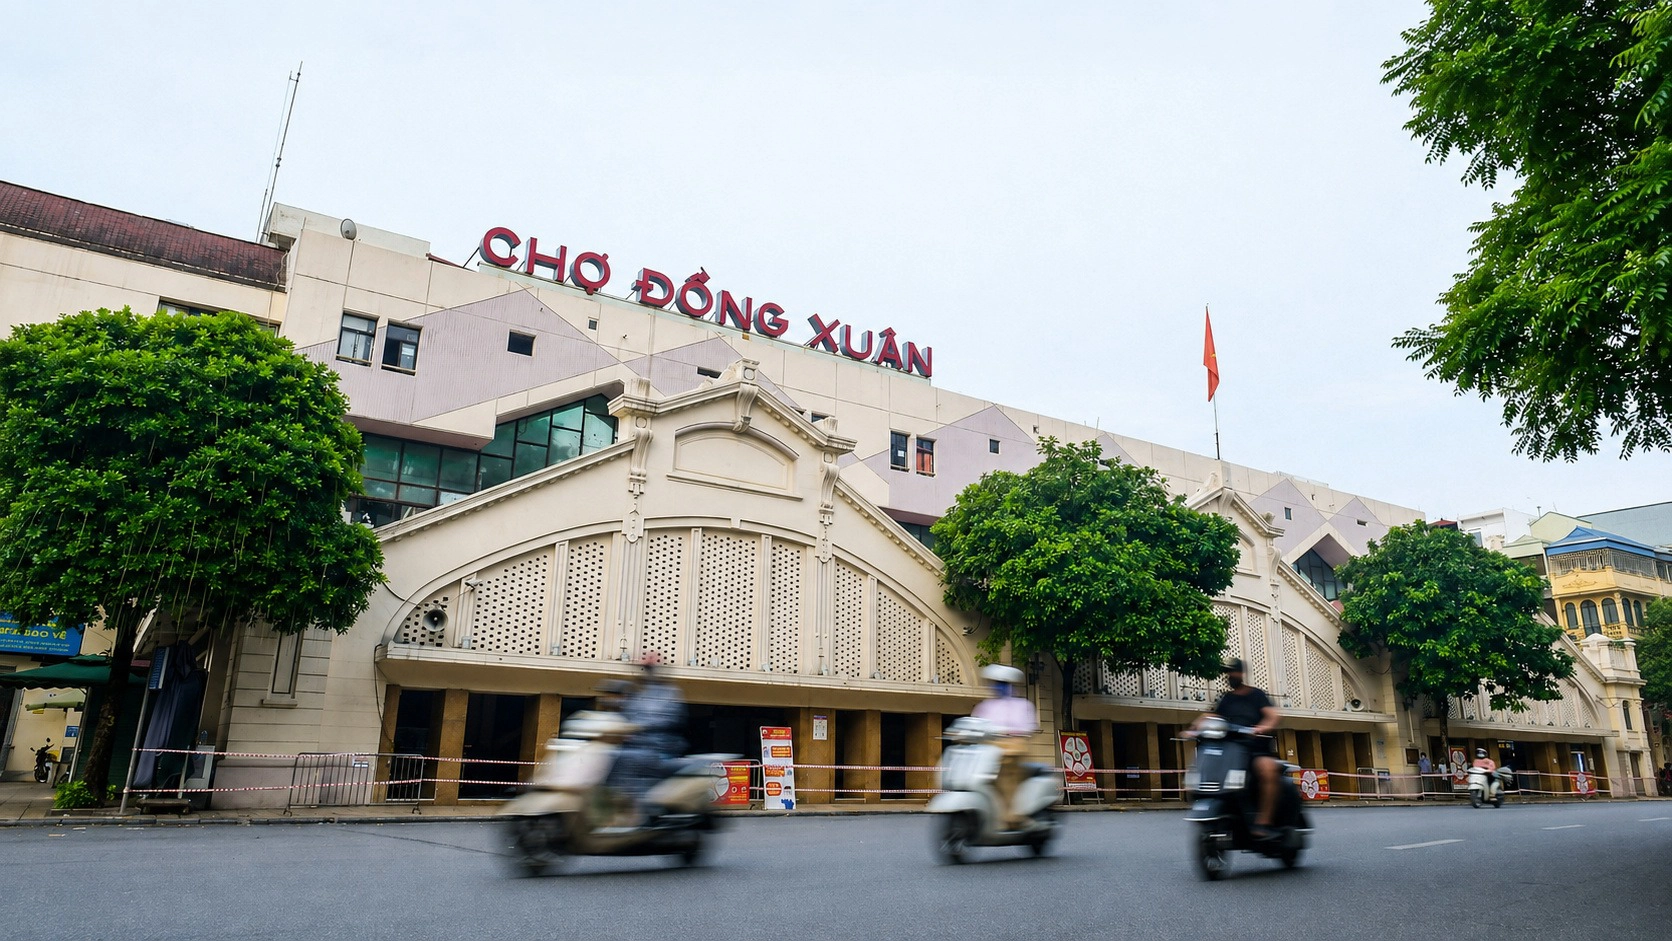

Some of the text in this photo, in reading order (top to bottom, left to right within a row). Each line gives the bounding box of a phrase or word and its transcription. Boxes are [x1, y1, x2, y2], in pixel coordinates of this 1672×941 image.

[479, 226, 933, 377] CHỢ ĐỒNG XUÂN
